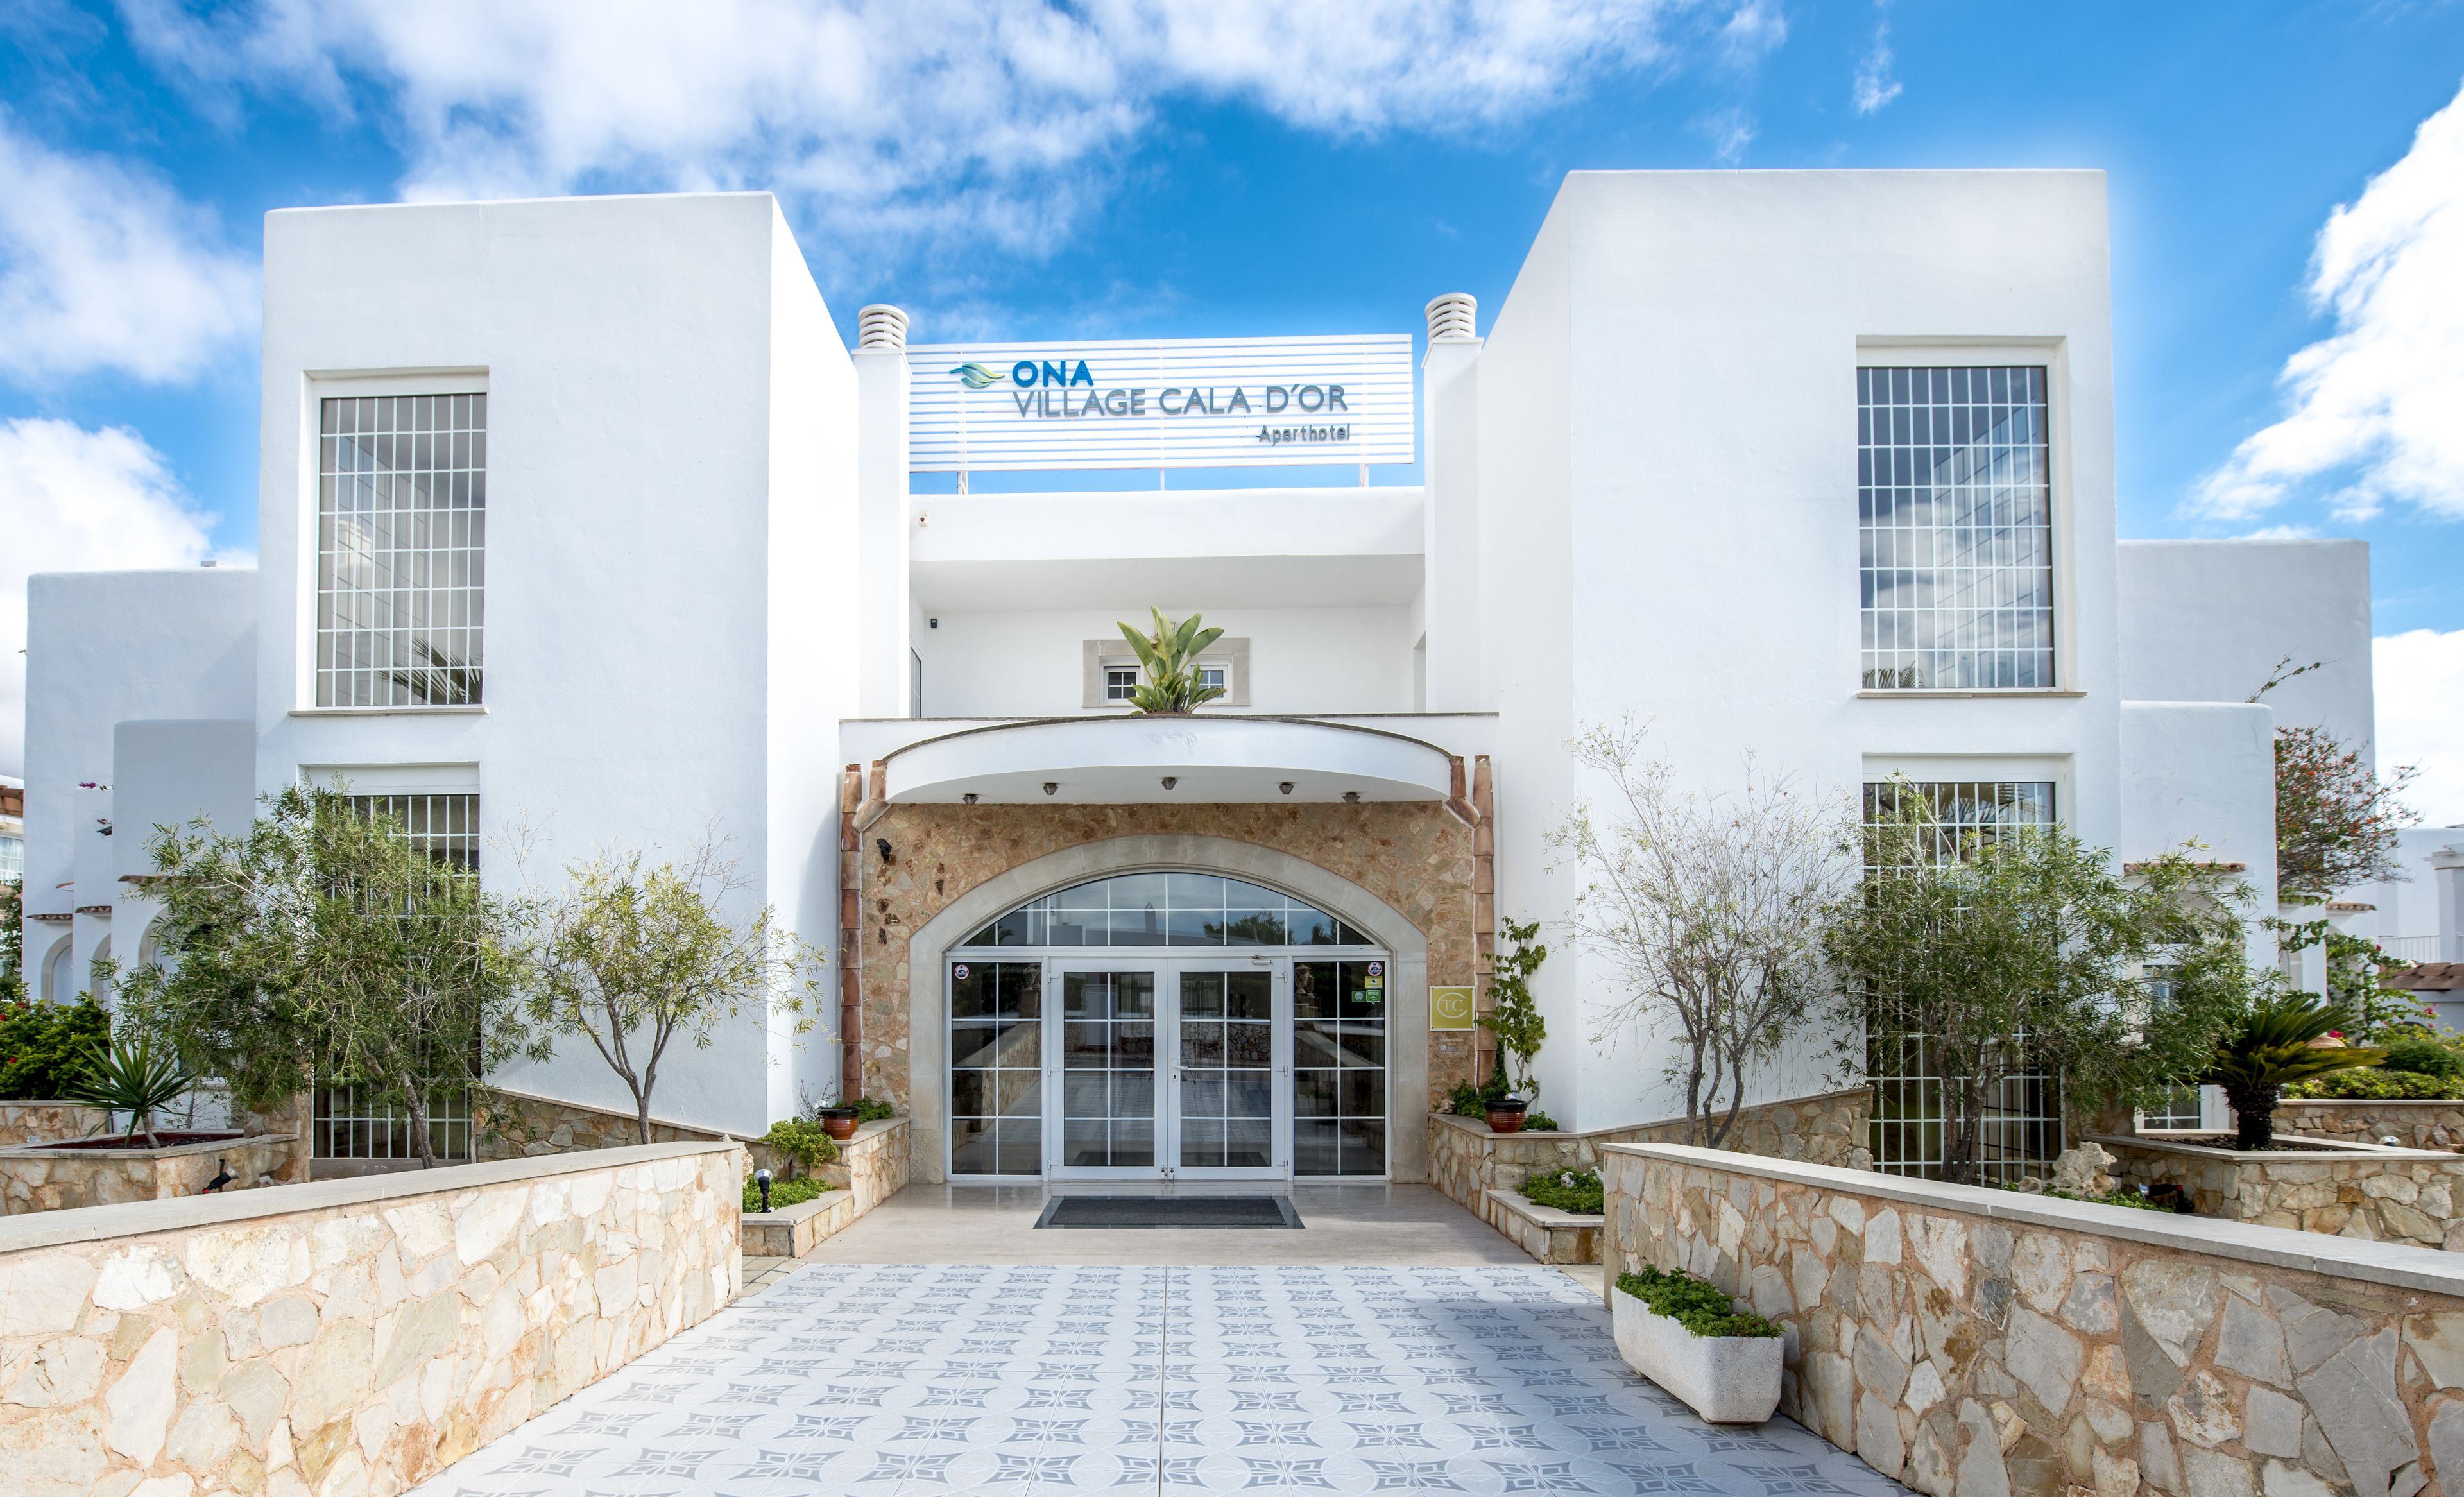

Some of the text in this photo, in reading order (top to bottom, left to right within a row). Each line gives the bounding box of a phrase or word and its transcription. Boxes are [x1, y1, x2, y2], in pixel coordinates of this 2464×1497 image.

[1012, 359, 1094, 388] ONA
[1013, 388, 1146, 418] VILLAGE
[1159, 386, 1251, 415] CALA
[1259, 423, 1351, 446] Aparthotel
